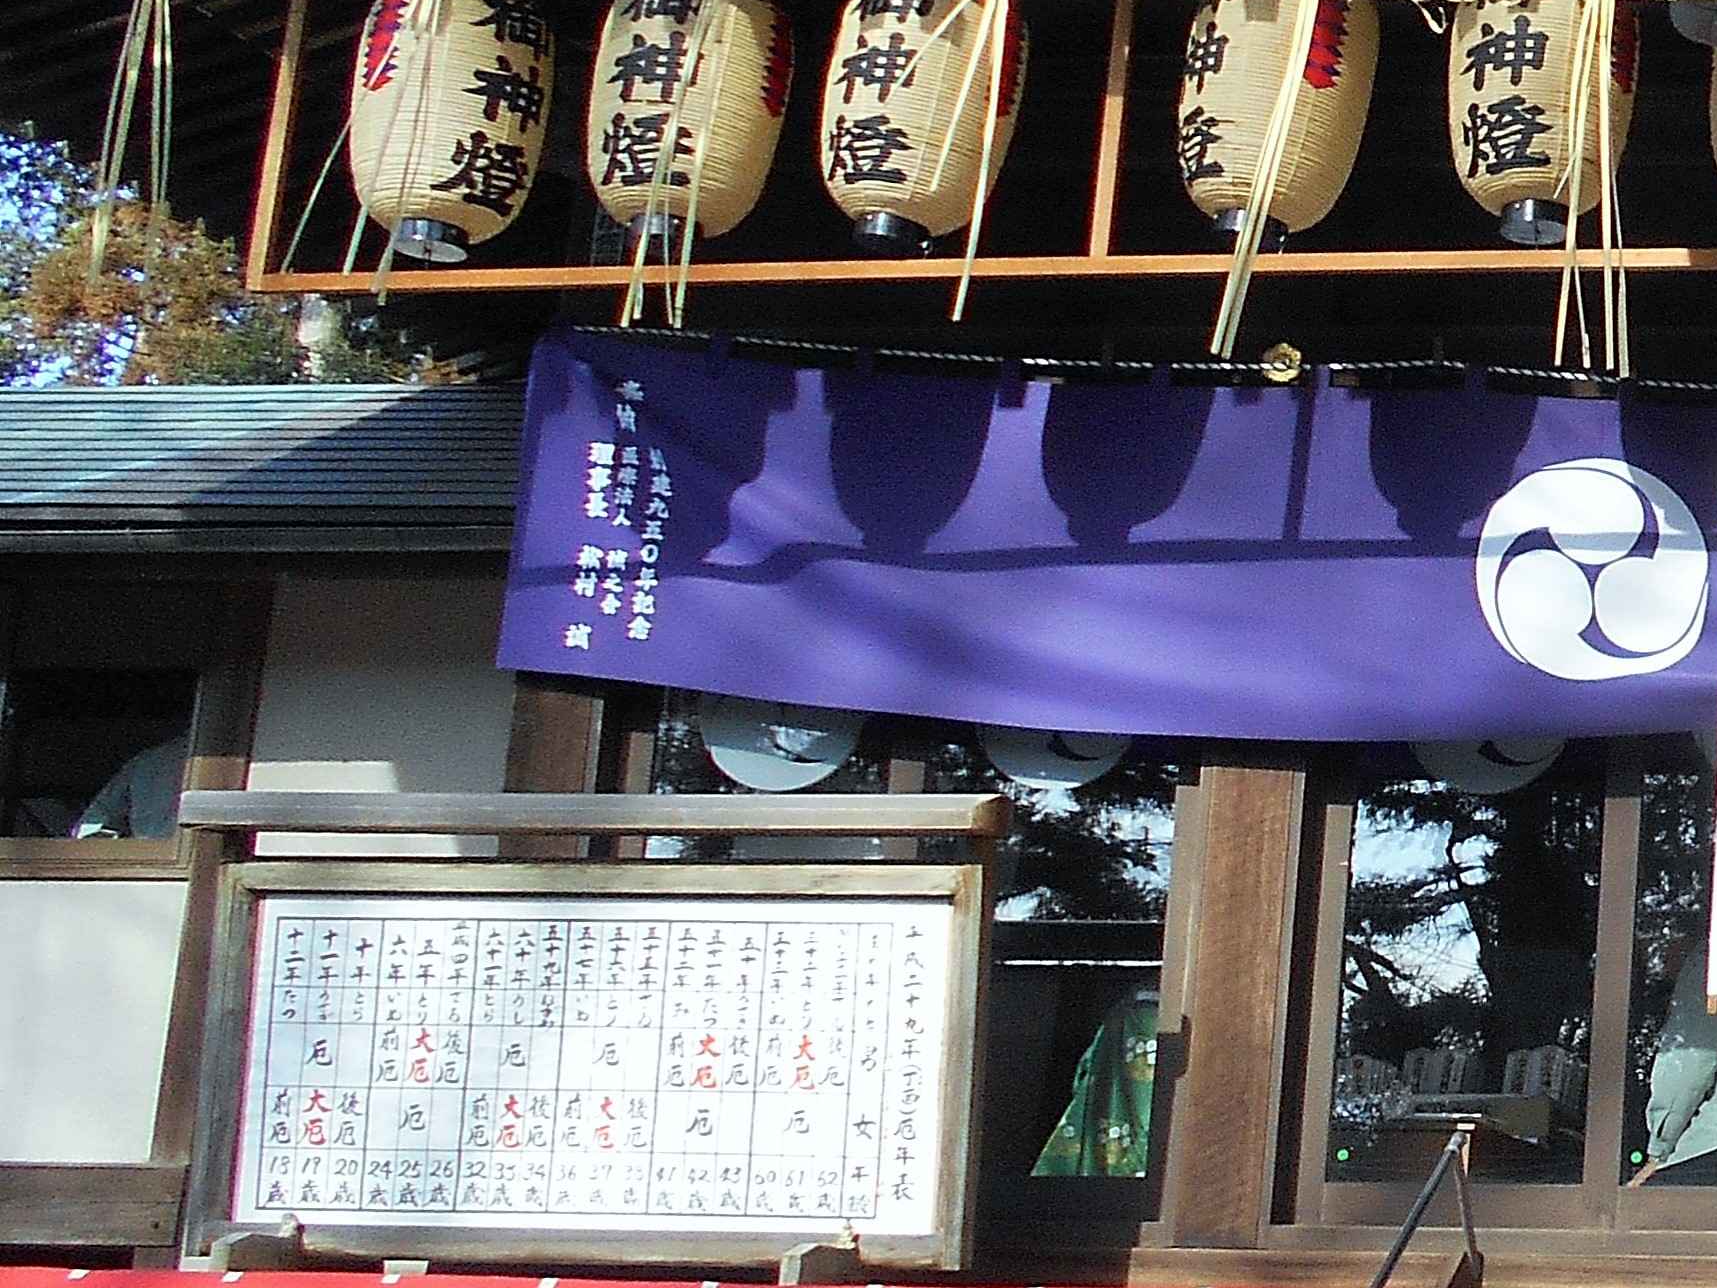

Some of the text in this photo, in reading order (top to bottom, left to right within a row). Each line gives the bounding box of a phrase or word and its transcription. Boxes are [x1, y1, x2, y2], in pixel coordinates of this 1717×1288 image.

[284, 928, 305, 984] 十二年
[318, 929, 339, 985] 十一年
[350, 937, 374, 983] 十年
[387, 934, 408, 984] 六年
[416, 939, 441, 986] 五年
[511, 928, 535, 990] 六十年
[541, 925, 563, 990] 五十九年
[305, 1039, 333, 1066] 厄
[376, 1027, 399, 1082] 前厄
[408, 1028, 436, 1083] 大厄
[437, 1030, 464, 1083] 後厄
[500, 1044, 526, 1067] 厄
[592, 1043, 619, 1066] 厄
[690, 1033, 722, 1088] 大厄
[790, 1034, 816, 1090] 大厄
[860, 1046, 878, 1073] 男
[270, 1088, 291, 1144] 前厄
[302, 1089, 332, 1146] 大厄
[334, 1091, 363, 1146] 後厄
[399, 1104, 425, 1131] 厄
[465, 1093, 489, 1147] 前厄
[496, 1094, 524, 1148] 大厄
[525, 1095, 550, 1147] 後厄
[594, 1096, 617, 1149] 大厄
[685, 1109, 713, 1136] 厄
[784, 1110, 810, 1134] 厄
[853, 1113, 877, 1140] 女
